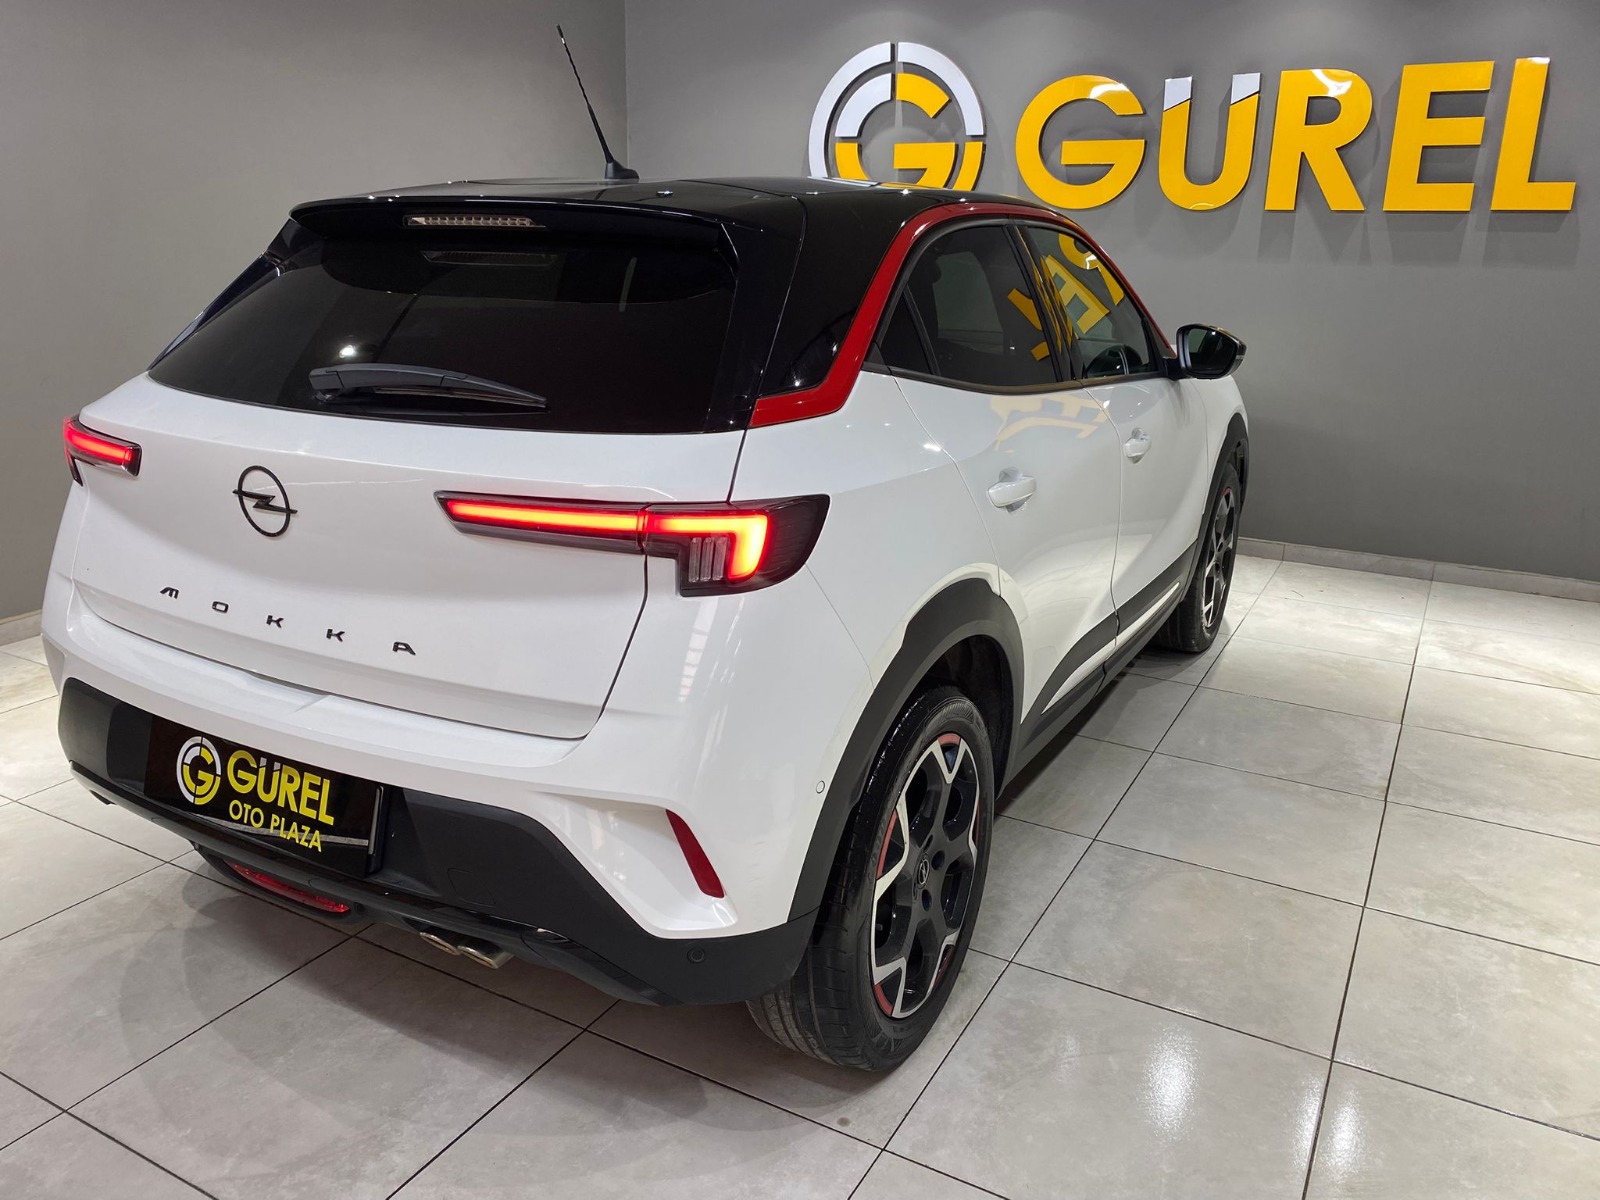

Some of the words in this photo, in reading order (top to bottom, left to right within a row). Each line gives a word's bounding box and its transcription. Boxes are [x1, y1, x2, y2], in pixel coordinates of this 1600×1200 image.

[160, 587, 416, 655] MOKKA
[227, 750, 334, 825] GÜREL
[229, 800, 264, 828] OTO
[270, 814, 322, 852] PLAZA
